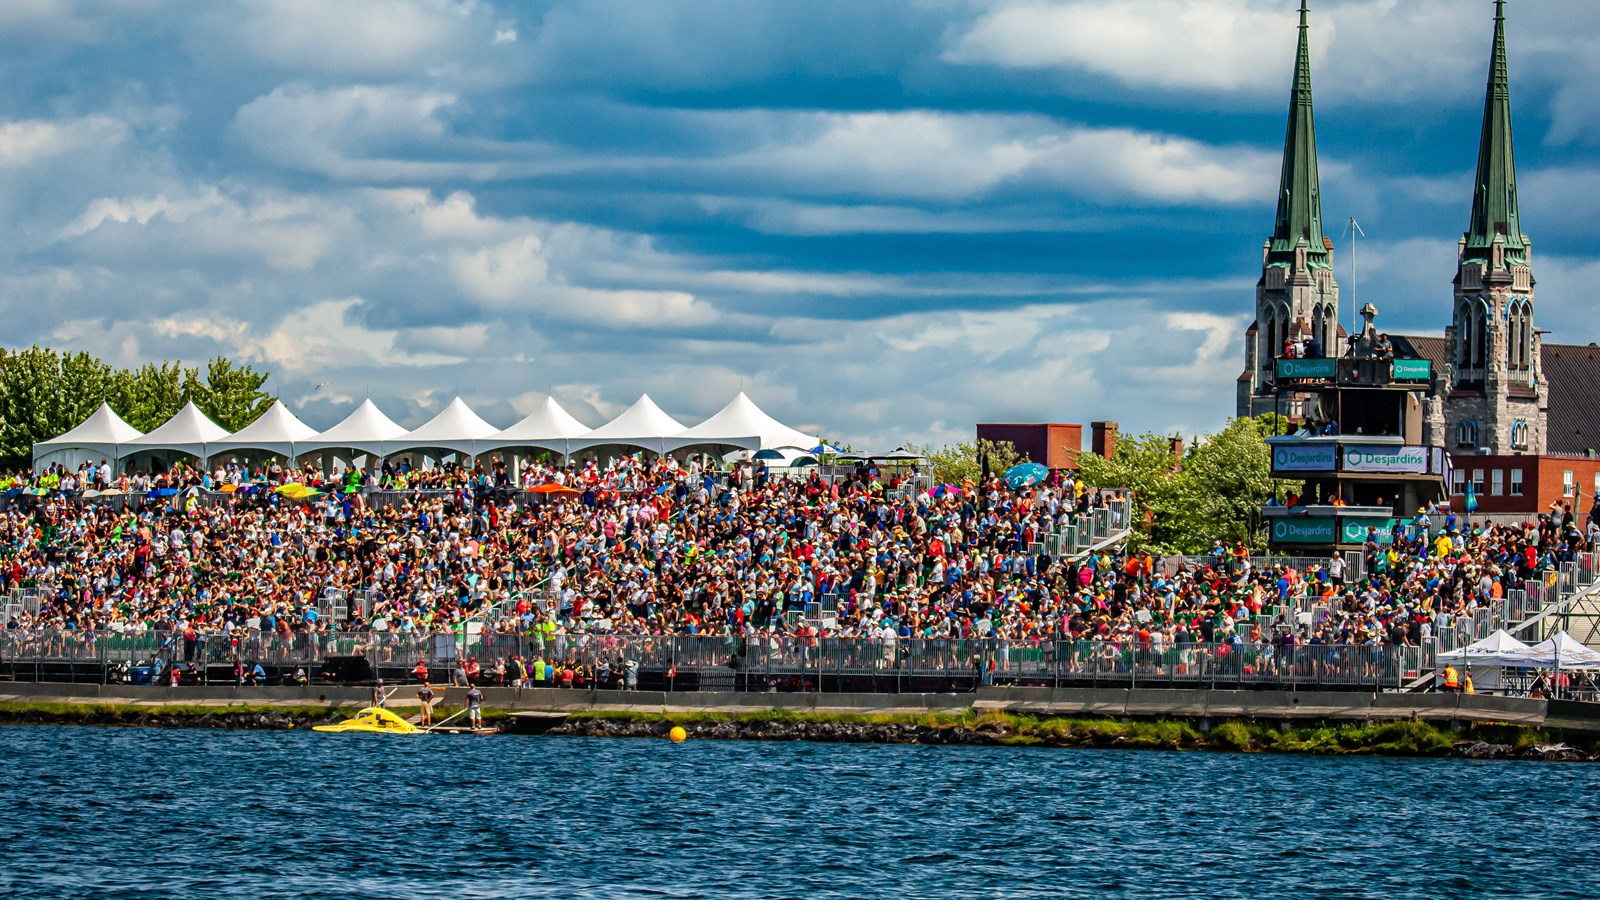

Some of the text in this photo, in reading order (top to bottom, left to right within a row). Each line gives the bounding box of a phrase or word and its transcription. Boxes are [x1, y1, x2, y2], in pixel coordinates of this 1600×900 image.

[1295, 364, 1329, 375] Desjardins
[1290, 451, 1333, 464] Desjardins
[1365, 452, 1423, 466] Desjardins
[1289, 524, 1332, 538] Desjardins
